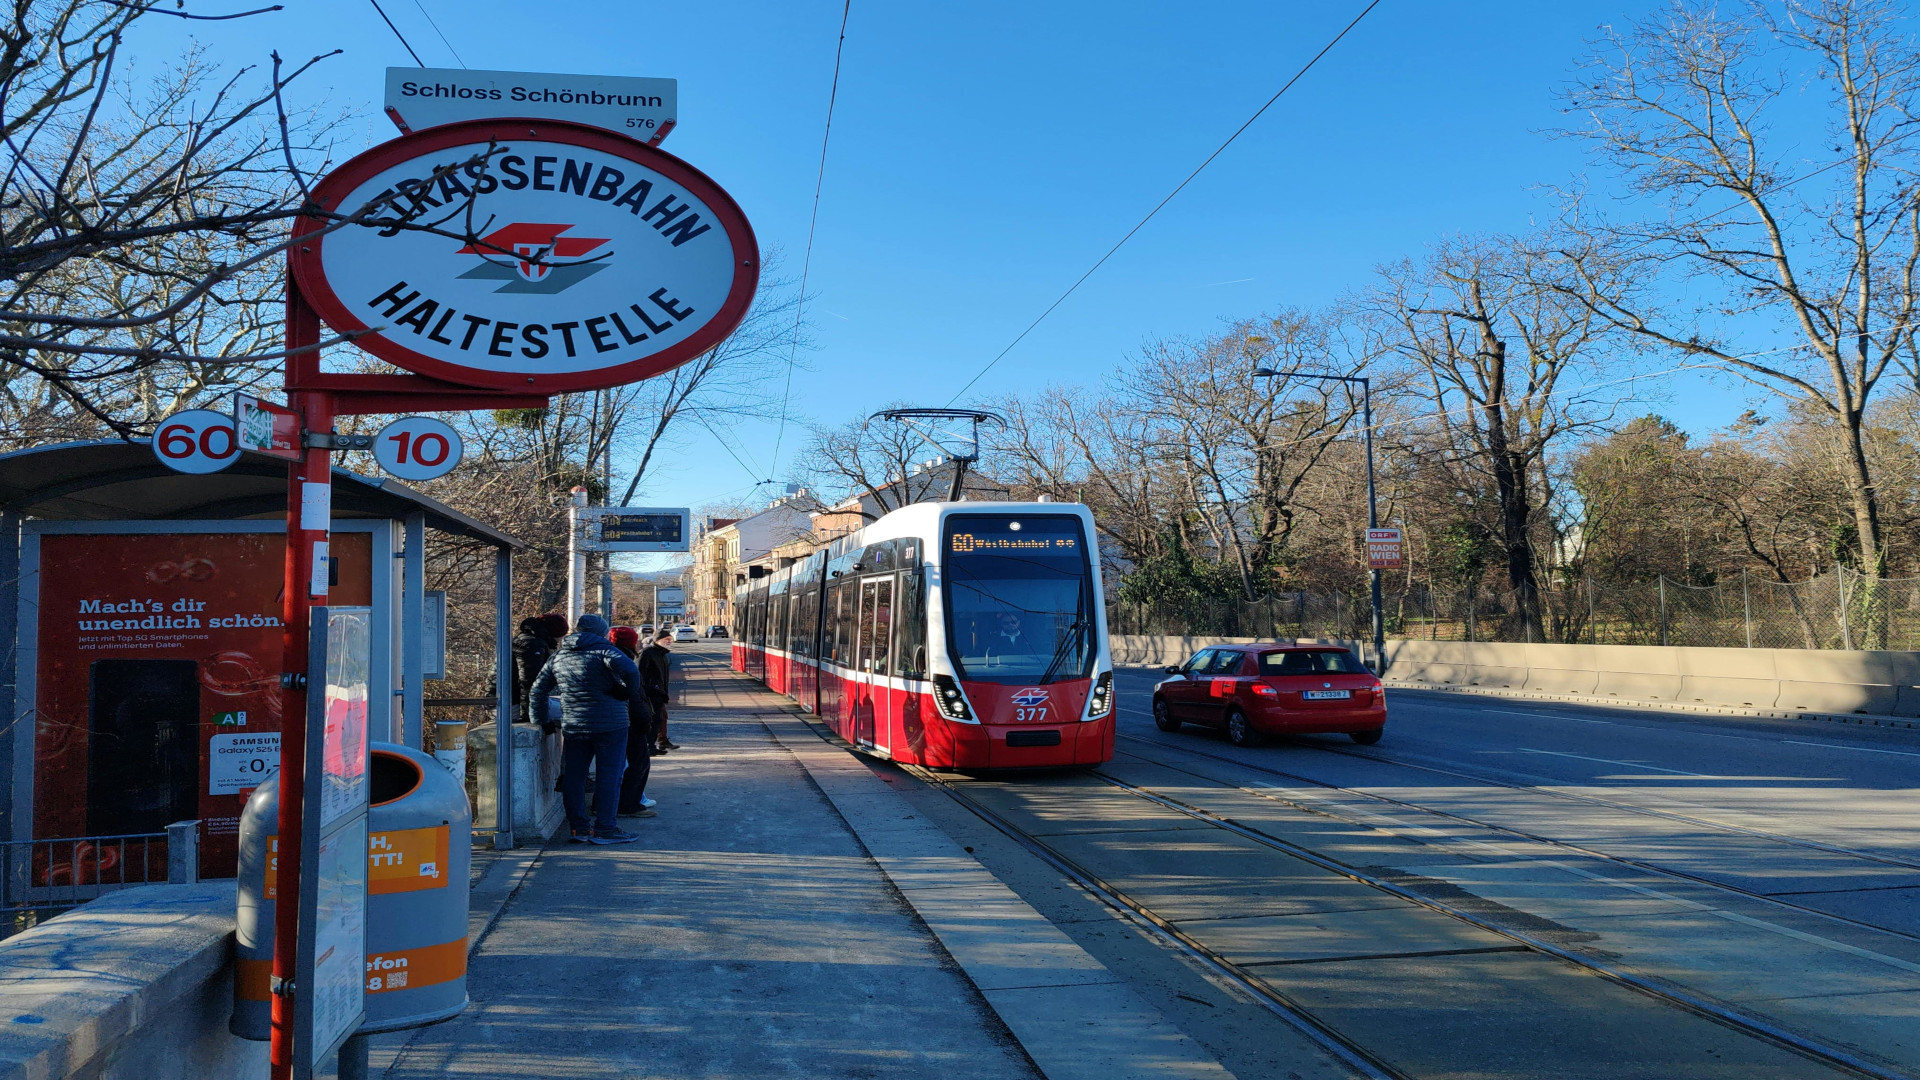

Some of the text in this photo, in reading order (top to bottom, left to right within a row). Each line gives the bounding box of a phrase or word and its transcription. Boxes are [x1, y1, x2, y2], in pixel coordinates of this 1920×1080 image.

[401, 82, 663, 107] Schloss Schönbrunn
[626, 118, 656, 129] 576
[360, 155, 712, 247] STRASSENBAHN
[368, 280, 696, 359] HALTESTELLE
[158, 424, 237, 460] 60
[388, 431, 450, 467] 10
[952, 534, 1050, 552] 60 Westbahnhof
[171, 598, 207, 612] dir
[78, 613, 286, 631] unendlich schön.
[78, 635, 99, 643] Jetzt
[101, 634, 115, 642] mit
[117, 634, 133, 643] Top
[150, 633, 209, 642] Smartphones
[98, 642, 154, 650] unlimitierten
[156, 641, 185, 649] Daten.
[221, 713, 235, 724] A
[1016, 707, 1048, 721] 377
[232, 737, 280, 746] SAMSUN
[218, 747, 254, 755] Galaxy
[370, 836, 393, 850] H,
[369, 852, 403, 867] TT!
